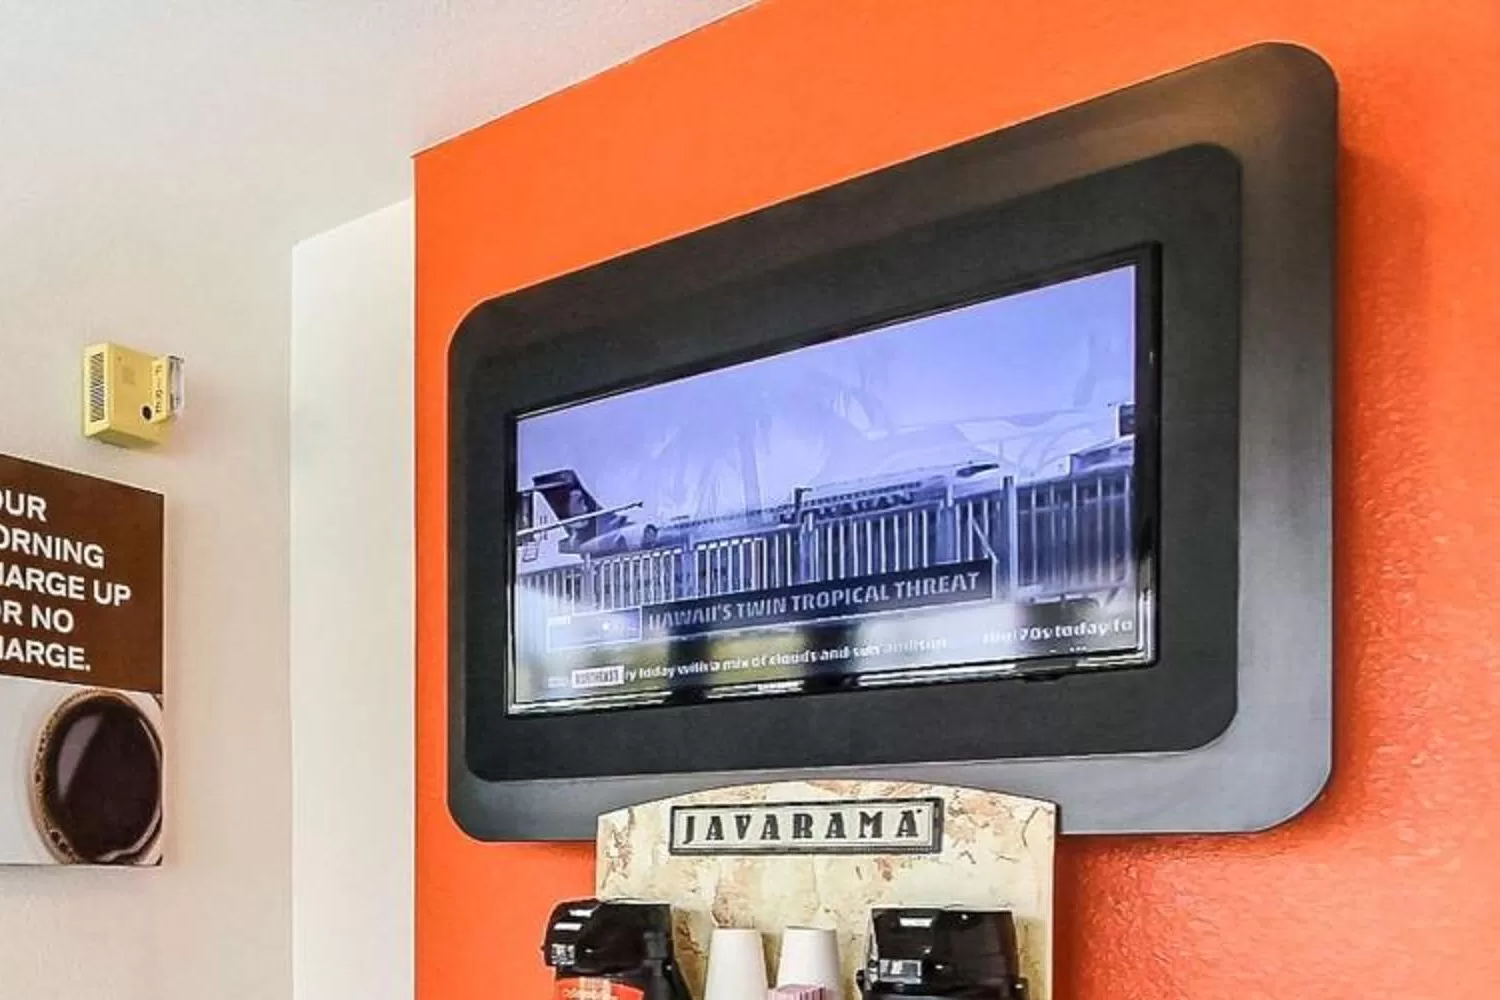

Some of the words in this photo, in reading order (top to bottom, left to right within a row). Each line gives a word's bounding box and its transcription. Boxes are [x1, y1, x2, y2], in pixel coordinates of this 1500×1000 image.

[93, 583, 132, 606] UP
[649, 603, 732, 630] HAWAII'S
[736, 597, 787, 618] TWIN
[792, 586, 890, 612] TROPICAL
[894, 571, 981, 598] THREAT
[31, 604, 75, 633] NO
[722, 656, 749, 671] mix
[768, 651, 817, 666] clouds
[820, 646, 850, 661] and
[1054, 621, 1109, 638] today
[682, 809, 920, 845] JAVARAMA
